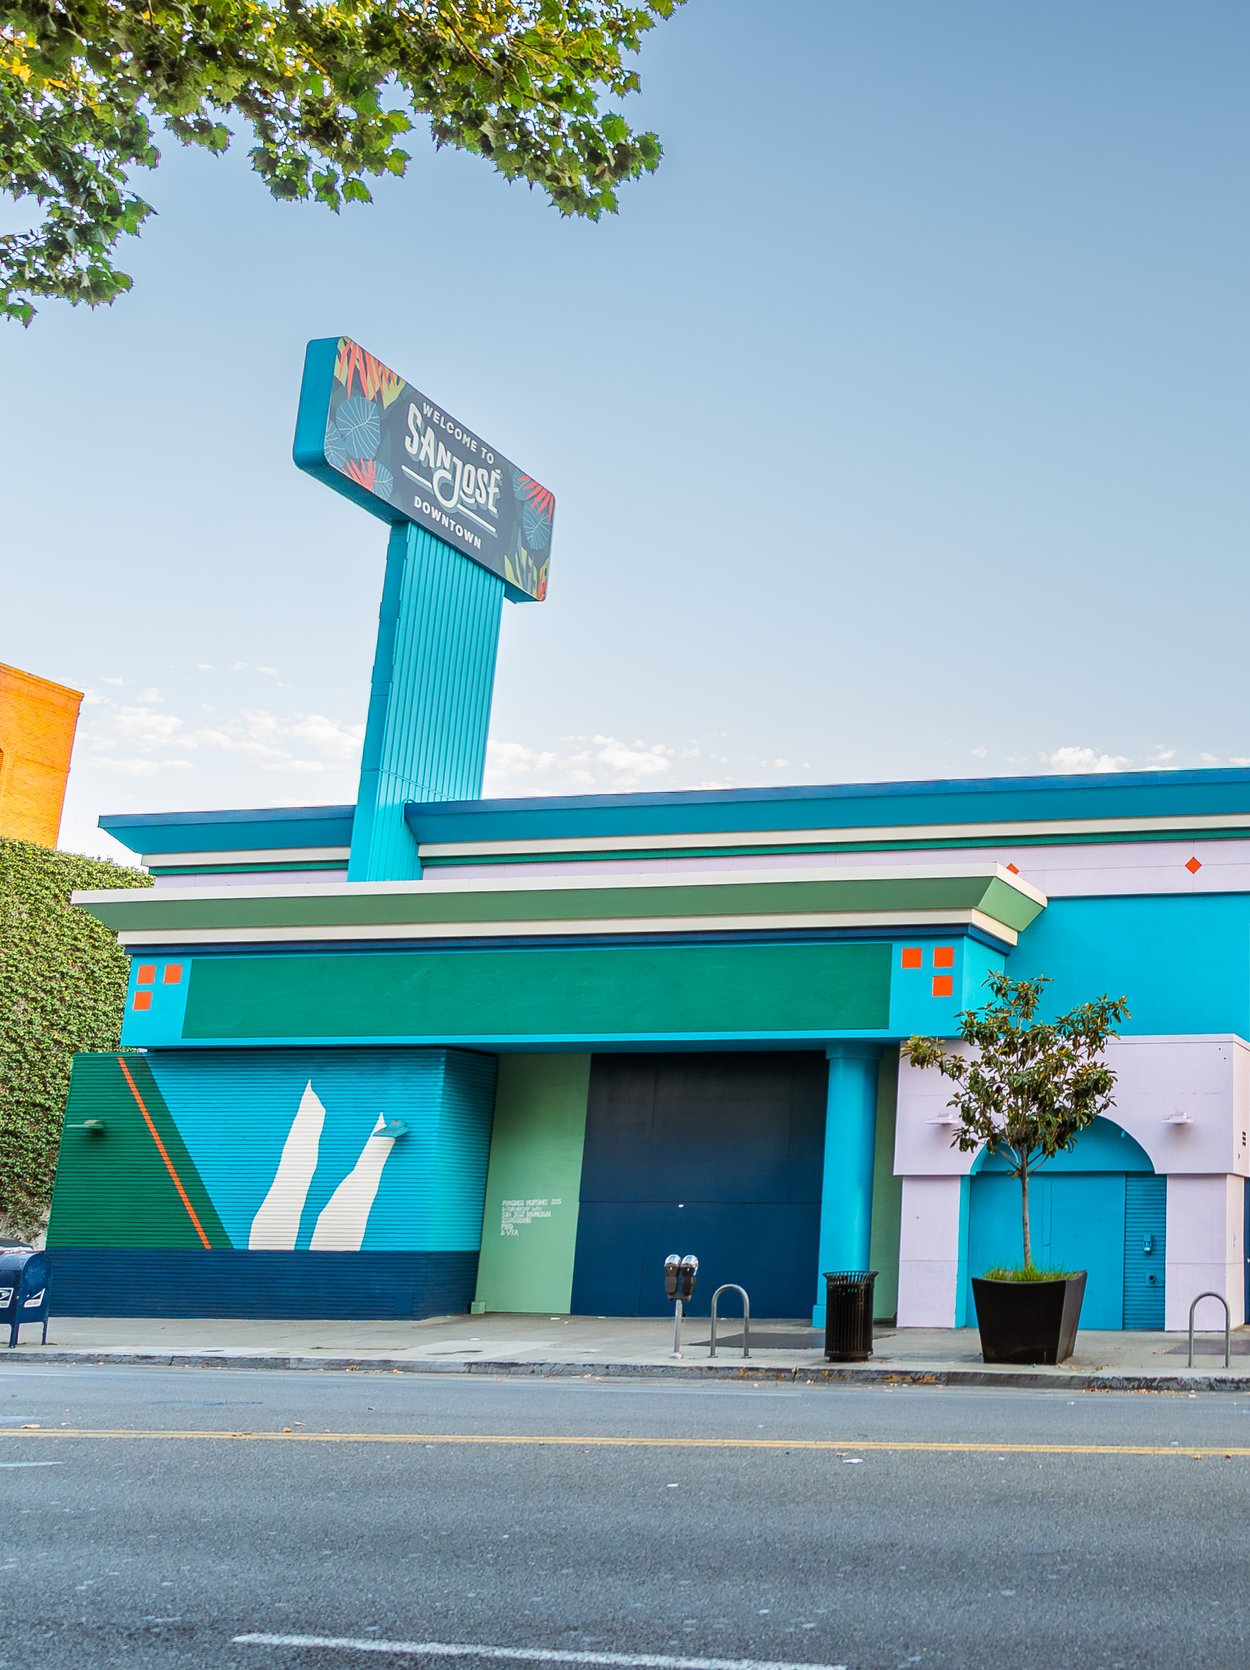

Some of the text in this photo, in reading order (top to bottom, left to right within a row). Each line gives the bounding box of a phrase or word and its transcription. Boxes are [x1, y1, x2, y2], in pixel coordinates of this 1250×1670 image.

[404, 402, 452, 469] SAN
[422, 401, 495, 465] WELCOME TO
[413, 495, 482, 550] DOWNTOWN
